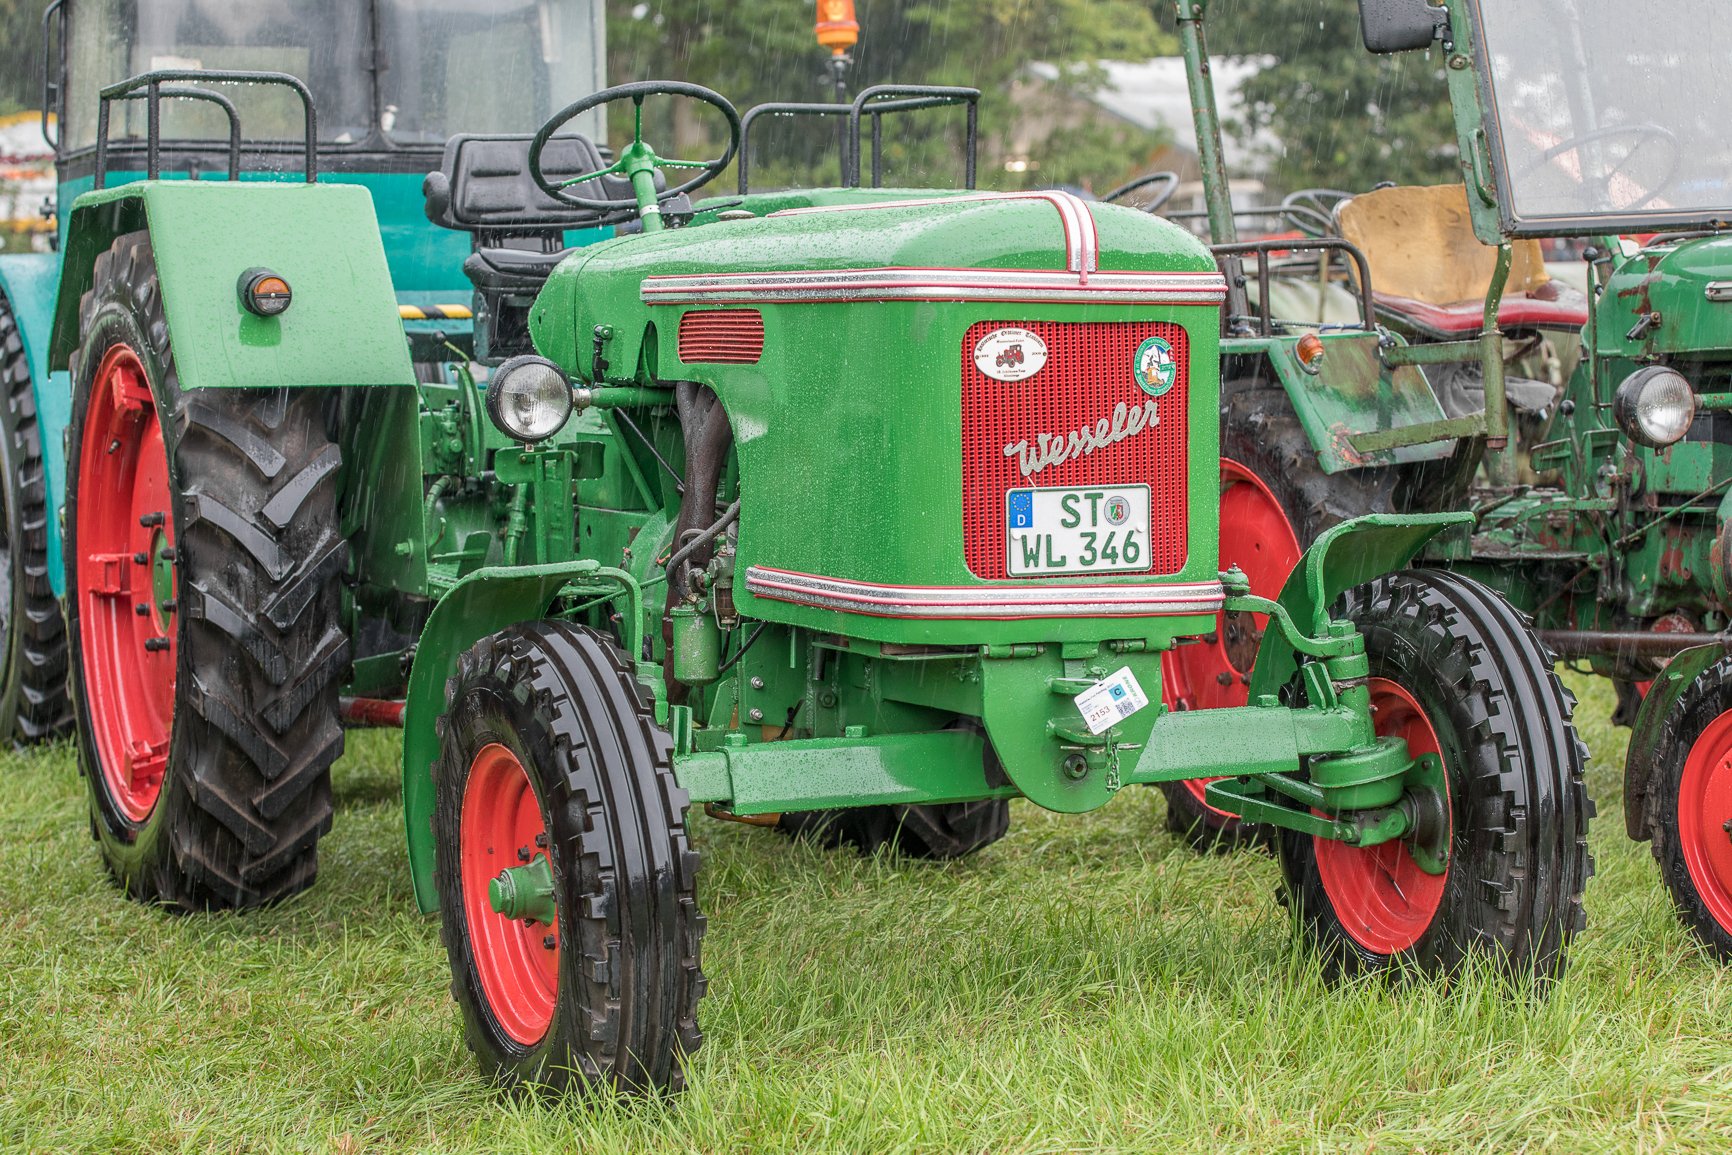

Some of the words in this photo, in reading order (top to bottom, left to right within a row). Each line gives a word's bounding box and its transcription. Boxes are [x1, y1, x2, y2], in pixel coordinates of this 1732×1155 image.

[1003, 399, 1161, 477] Wesseler
[1017, 514, 1026, 526] D
[1061, 492, 1104, 528] ST
[1021, 533, 1067, 568] WL
[1079, 529, 1140, 566] 346
[1114, 688, 1122, 696] C
[1090, 705, 1111, 722] 2153
